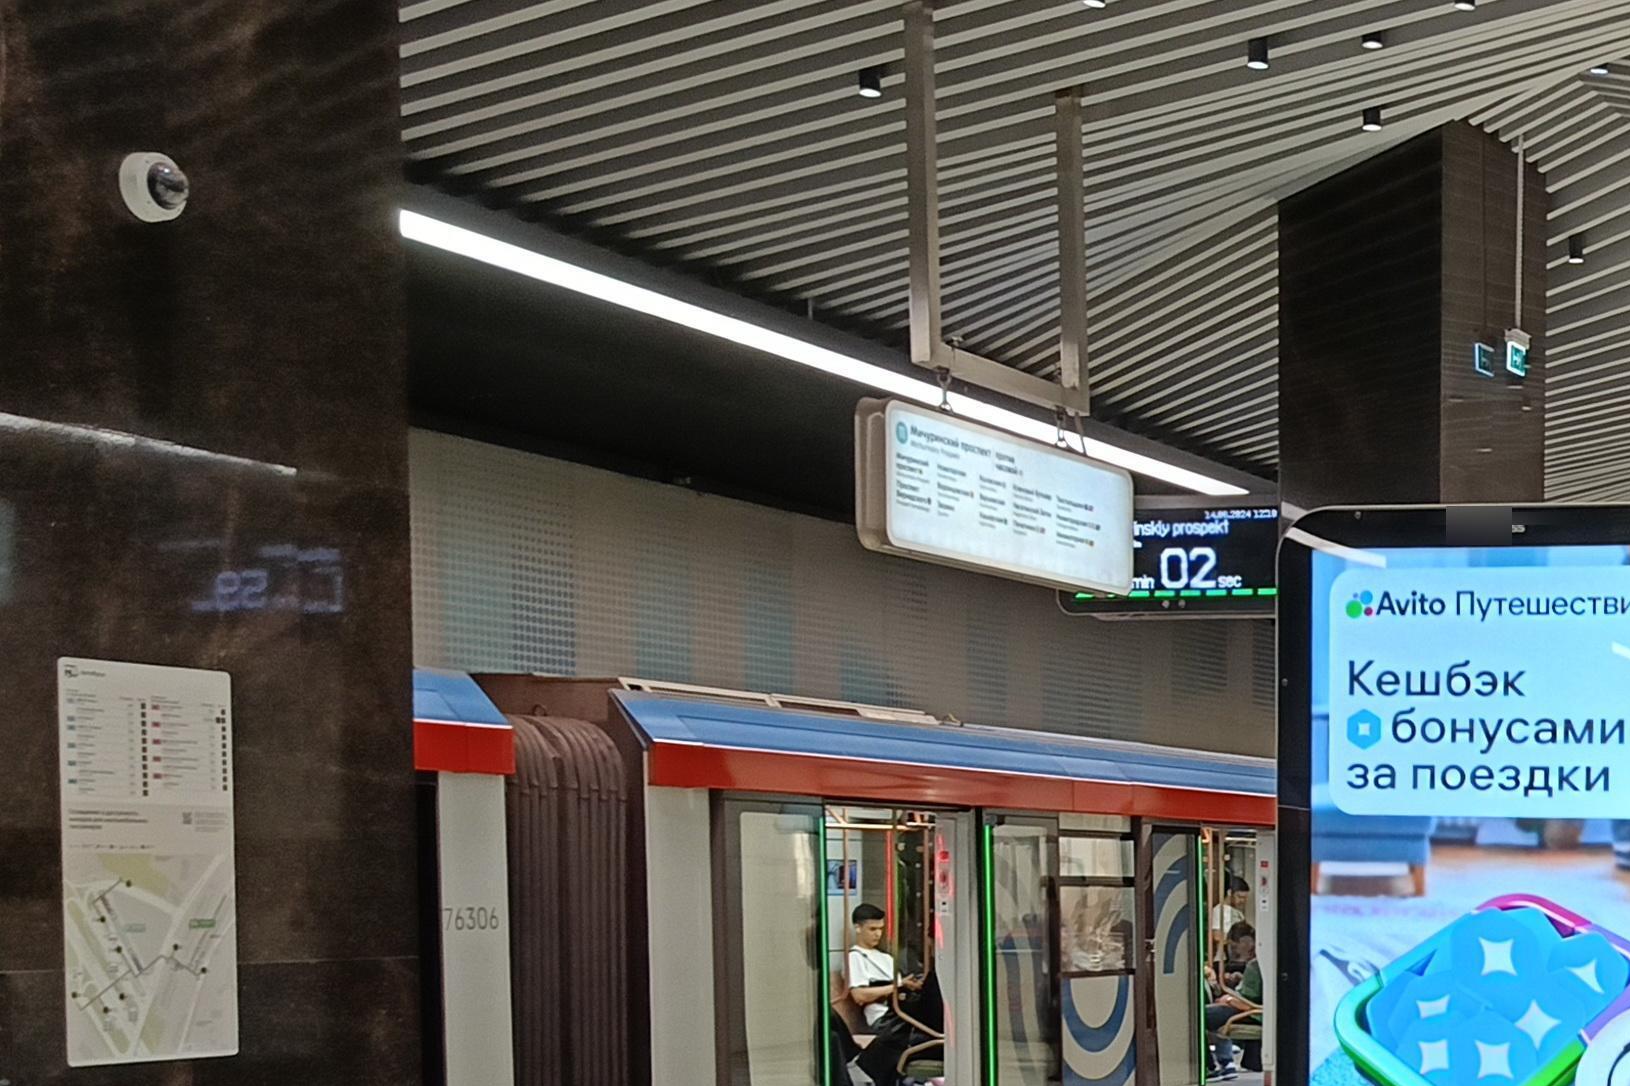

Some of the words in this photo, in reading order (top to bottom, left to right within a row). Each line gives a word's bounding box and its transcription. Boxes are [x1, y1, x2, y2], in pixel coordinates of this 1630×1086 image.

[1172, 519, 1230, 537] prospekt
[1160, 546, 1217, 589] 02
[1219, 574, 1242, 588] sec
[1376, 591, 1445, 617] Avito
[1348, 659, 1526, 697] Кешбэк
[1391, 708, 1626, 754] бонусами
[1347, 764, 1396, 790] за
[1411, 763, 1610, 799] поездки
[444, 907, 499, 931] 76306
